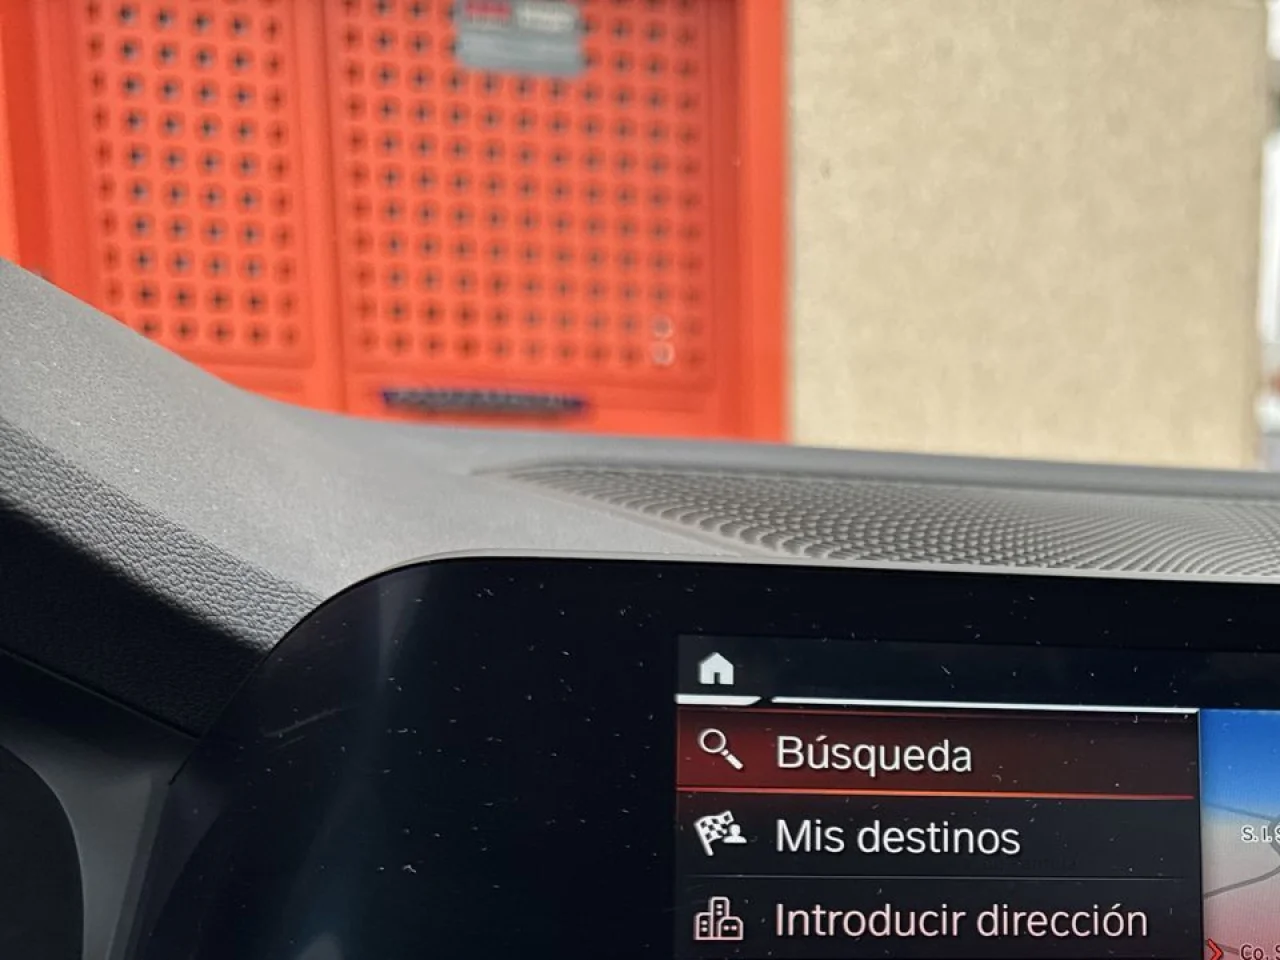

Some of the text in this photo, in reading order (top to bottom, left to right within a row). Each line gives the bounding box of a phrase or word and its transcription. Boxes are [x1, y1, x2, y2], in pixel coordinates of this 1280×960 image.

[776, 735, 972, 777] Búsqueda
[776, 819, 1021, 855] Mis destinos
[776, 903, 1148, 937] Introducir dirección
[1240, 946, 1268, 960] Co.
